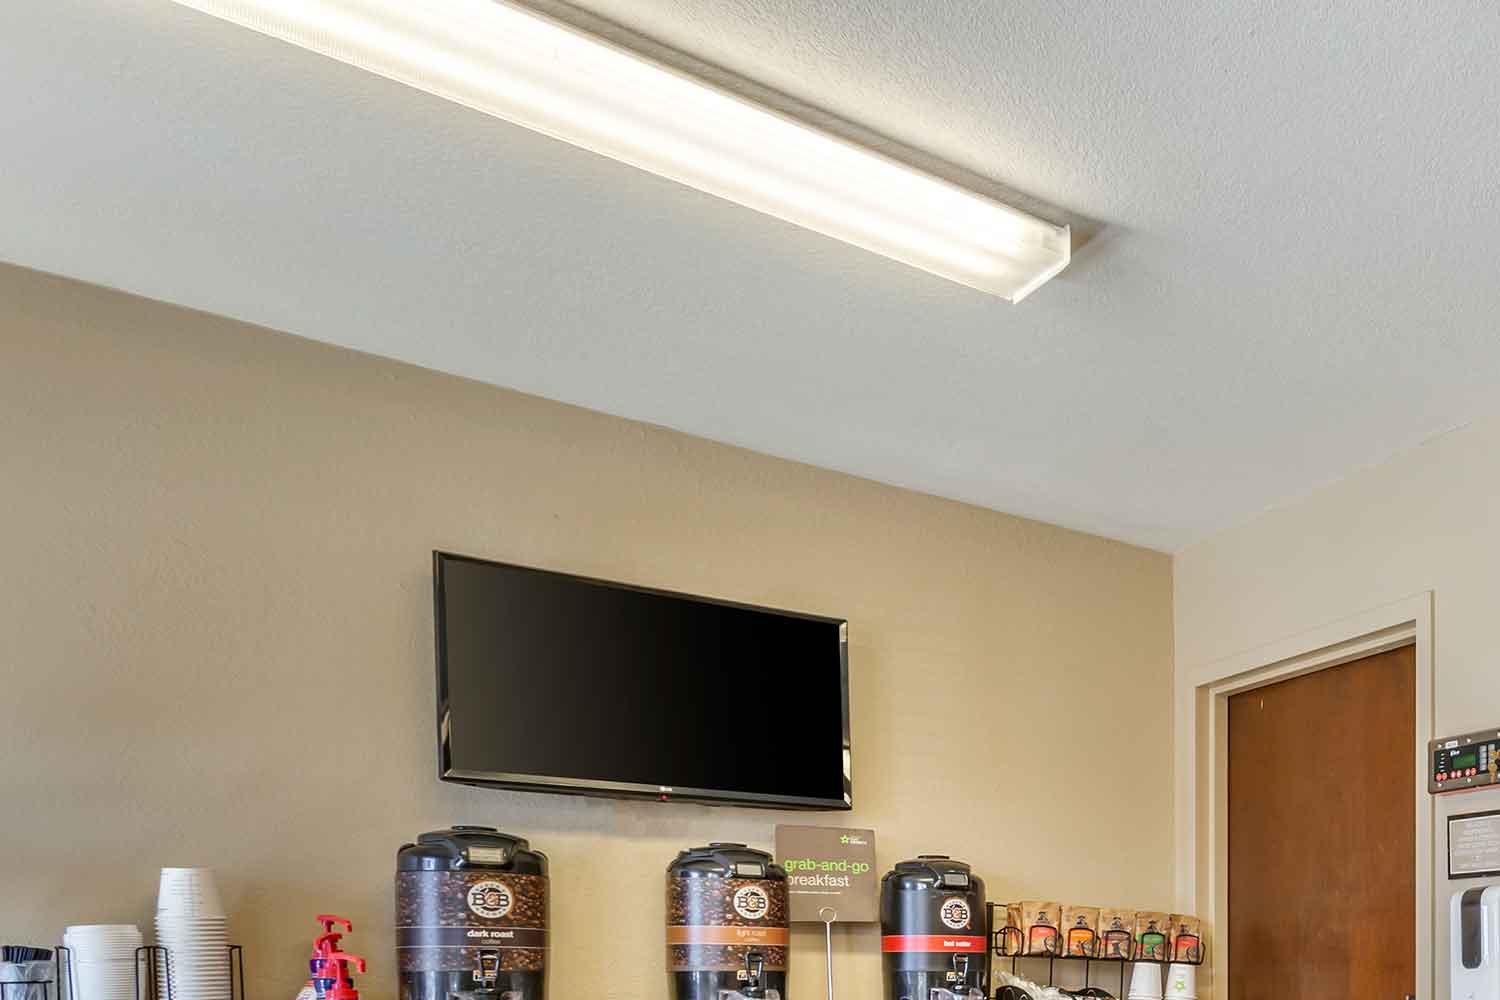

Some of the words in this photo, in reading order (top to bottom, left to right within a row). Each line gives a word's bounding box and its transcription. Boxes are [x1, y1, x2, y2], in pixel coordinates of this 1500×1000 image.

[784, 858, 870, 874] grab-and-go
[467, 929, 490, 939] dark
[490, 930, 514, 939] roast
